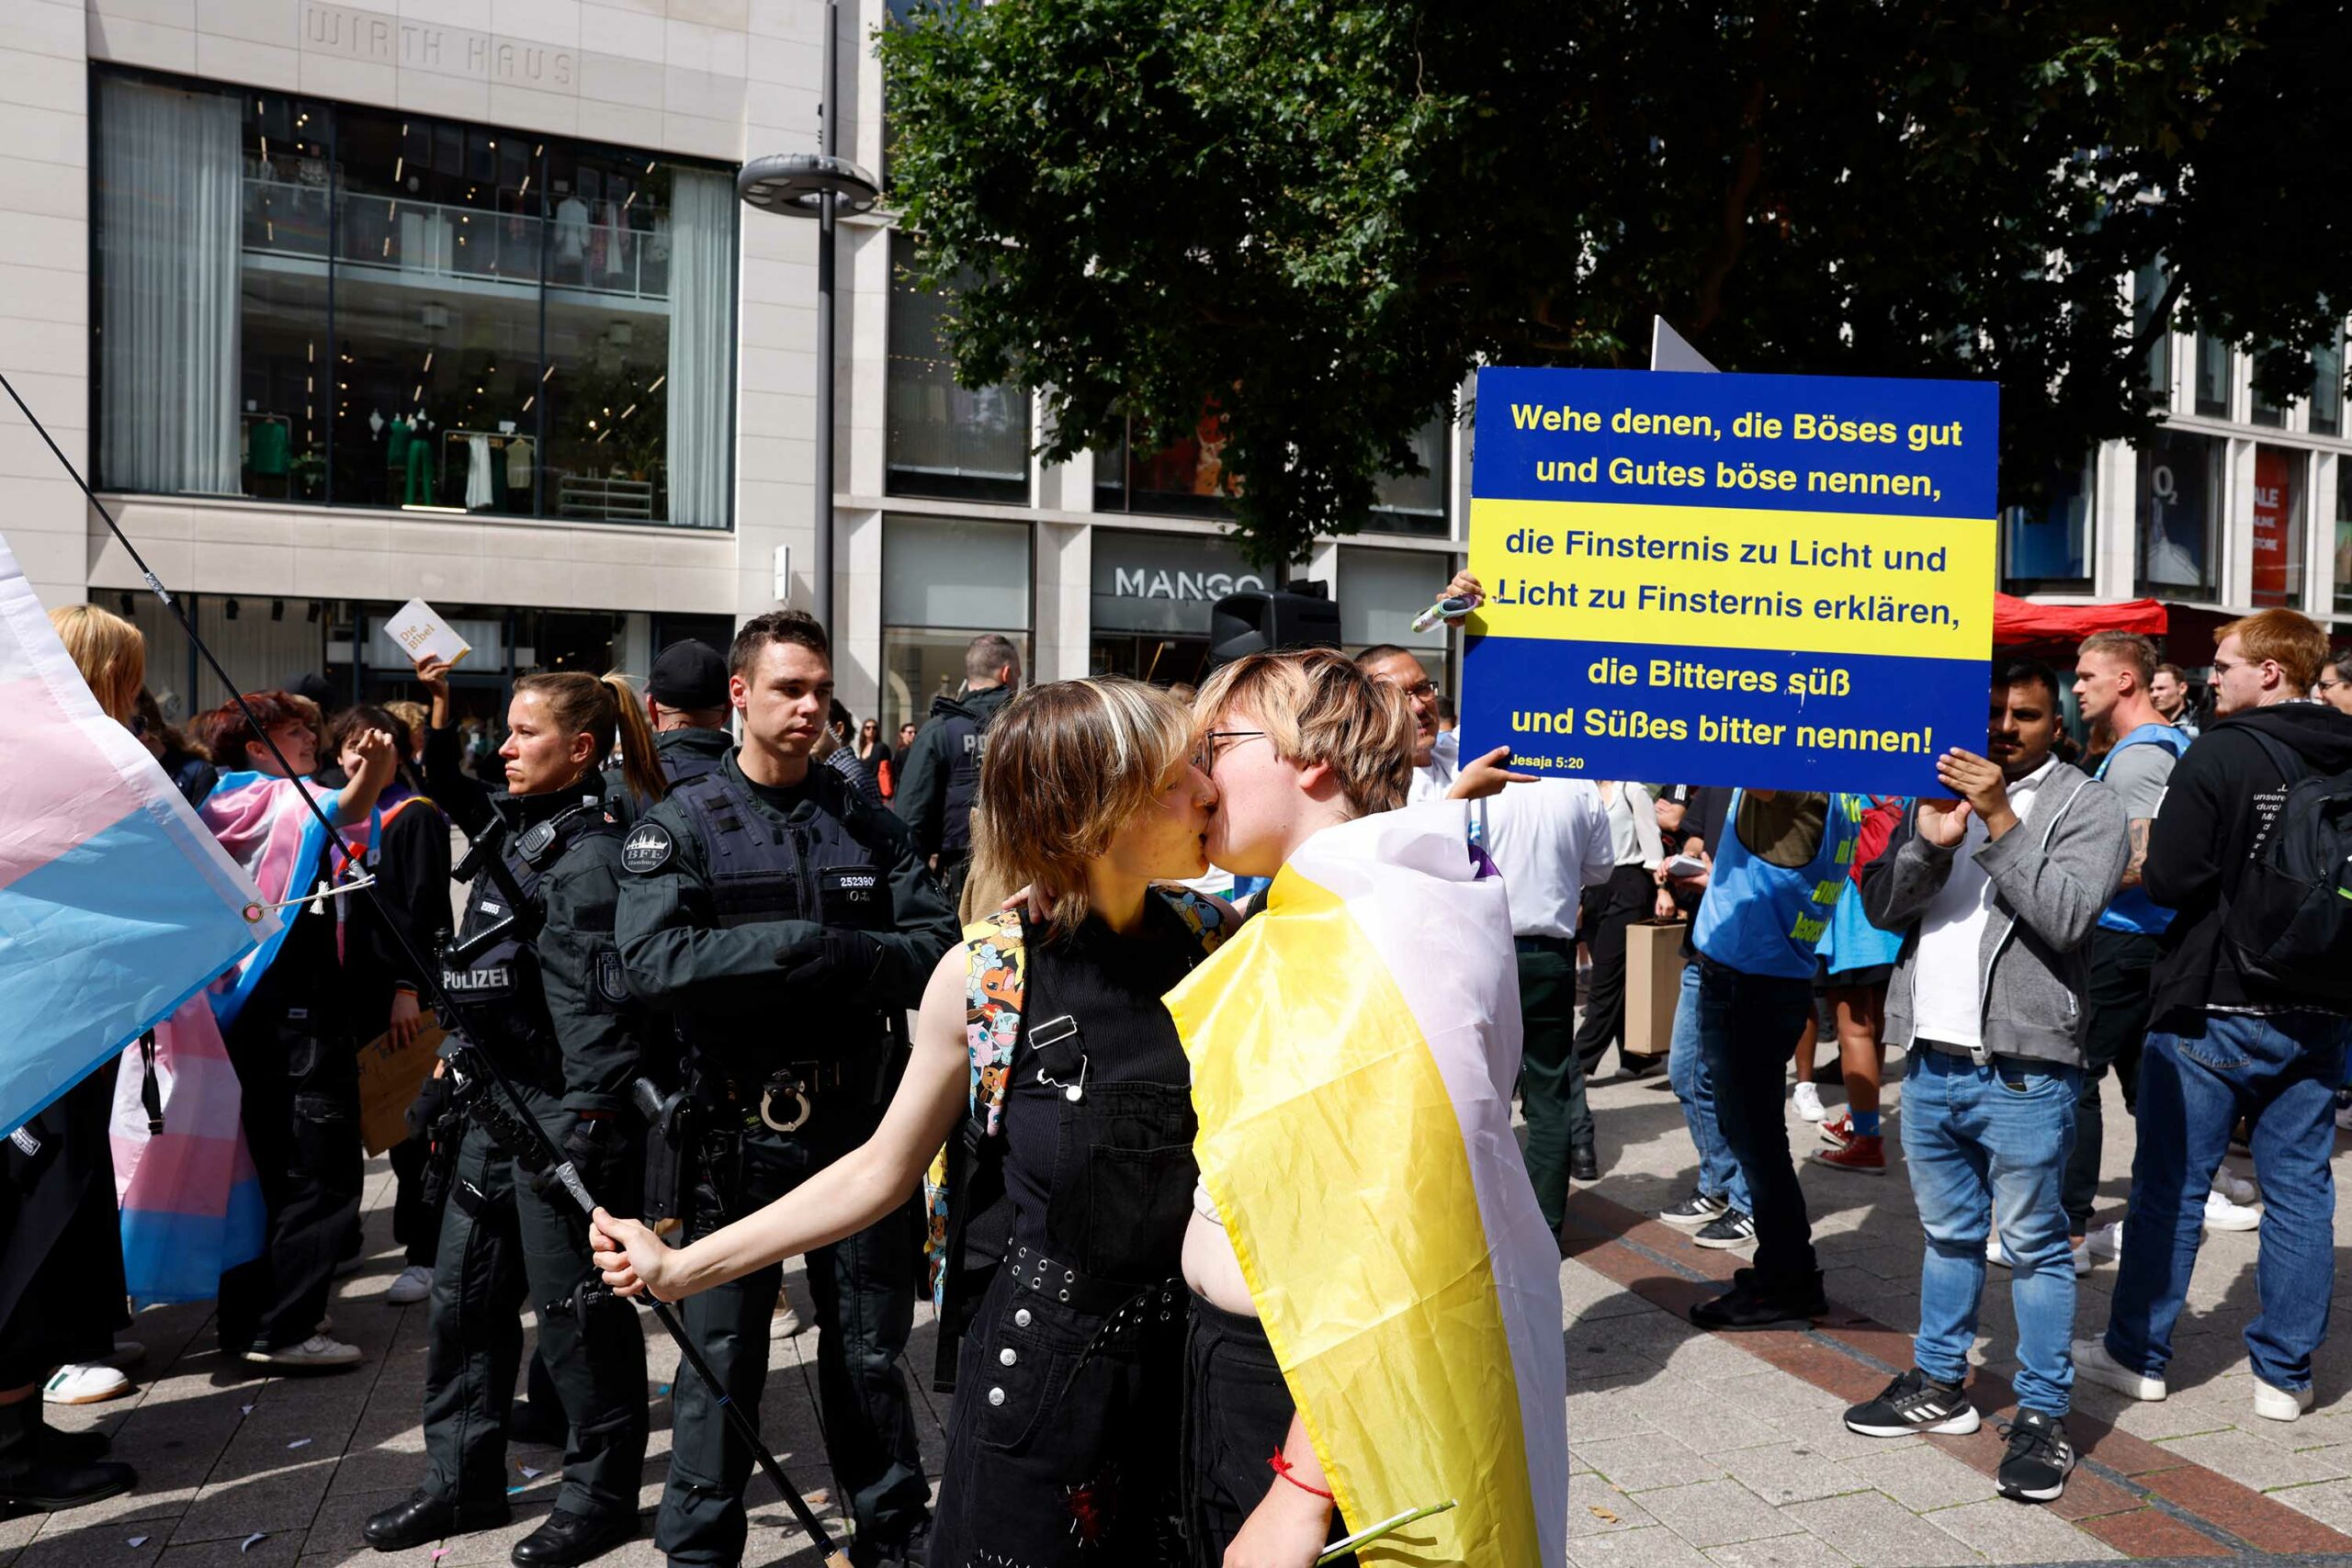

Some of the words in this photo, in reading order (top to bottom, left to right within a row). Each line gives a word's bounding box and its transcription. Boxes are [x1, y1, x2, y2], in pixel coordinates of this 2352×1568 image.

[307, 7, 444, 65] WIRTH
[466, 37, 571, 85] HAUS
[1511, 403, 1601, 433] Wehe
[1611, 408, 1721, 441] denen,
[1733, 412, 1782, 438] die
[1793, 413, 1897, 445] Böses
[1907, 421, 1962, 451] gut
[1537, 457, 1599, 483] und
[1609, 458, 1705, 488] Gutes
[1716, 462, 1797, 491] böse
[1808, 469, 1941, 502] nennen,
[1506, 529, 1554, 554] die
[1566, 531, 1729, 562] Finsternis
[1740, 544, 1777, 564] zu
[1791, 541, 1872, 569] Licht
[1884, 547, 1946, 571] und
[1498, 579, 1577, 607] Licht
[1589, 589, 1625, 609] zu
[1639, 585, 1803, 617] Finsternis
[1814, 596, 1960, 630] erklären,
[400, 625, 418, 642] Die
[408, 624, 435, 650] Bibel
[1589, 657, 1637, 685] die
[1648, 660, 1778, 693] Bitteres
[1788, 667, 1850, 696] süß
[1512, 706, 1574, 734] und
[1584, 707, 1688, 741] Süßes
[1699, 715, 1786, 746] bitter
[1797, 726, 1932, 754] nennen!
[1510, 754, 1552, 770] Jesaja
[1555, 757, 1584, 770] 5:20
[628, 849, 663, 860] BFE
[443, 966, 509, 989] POLIZEI
